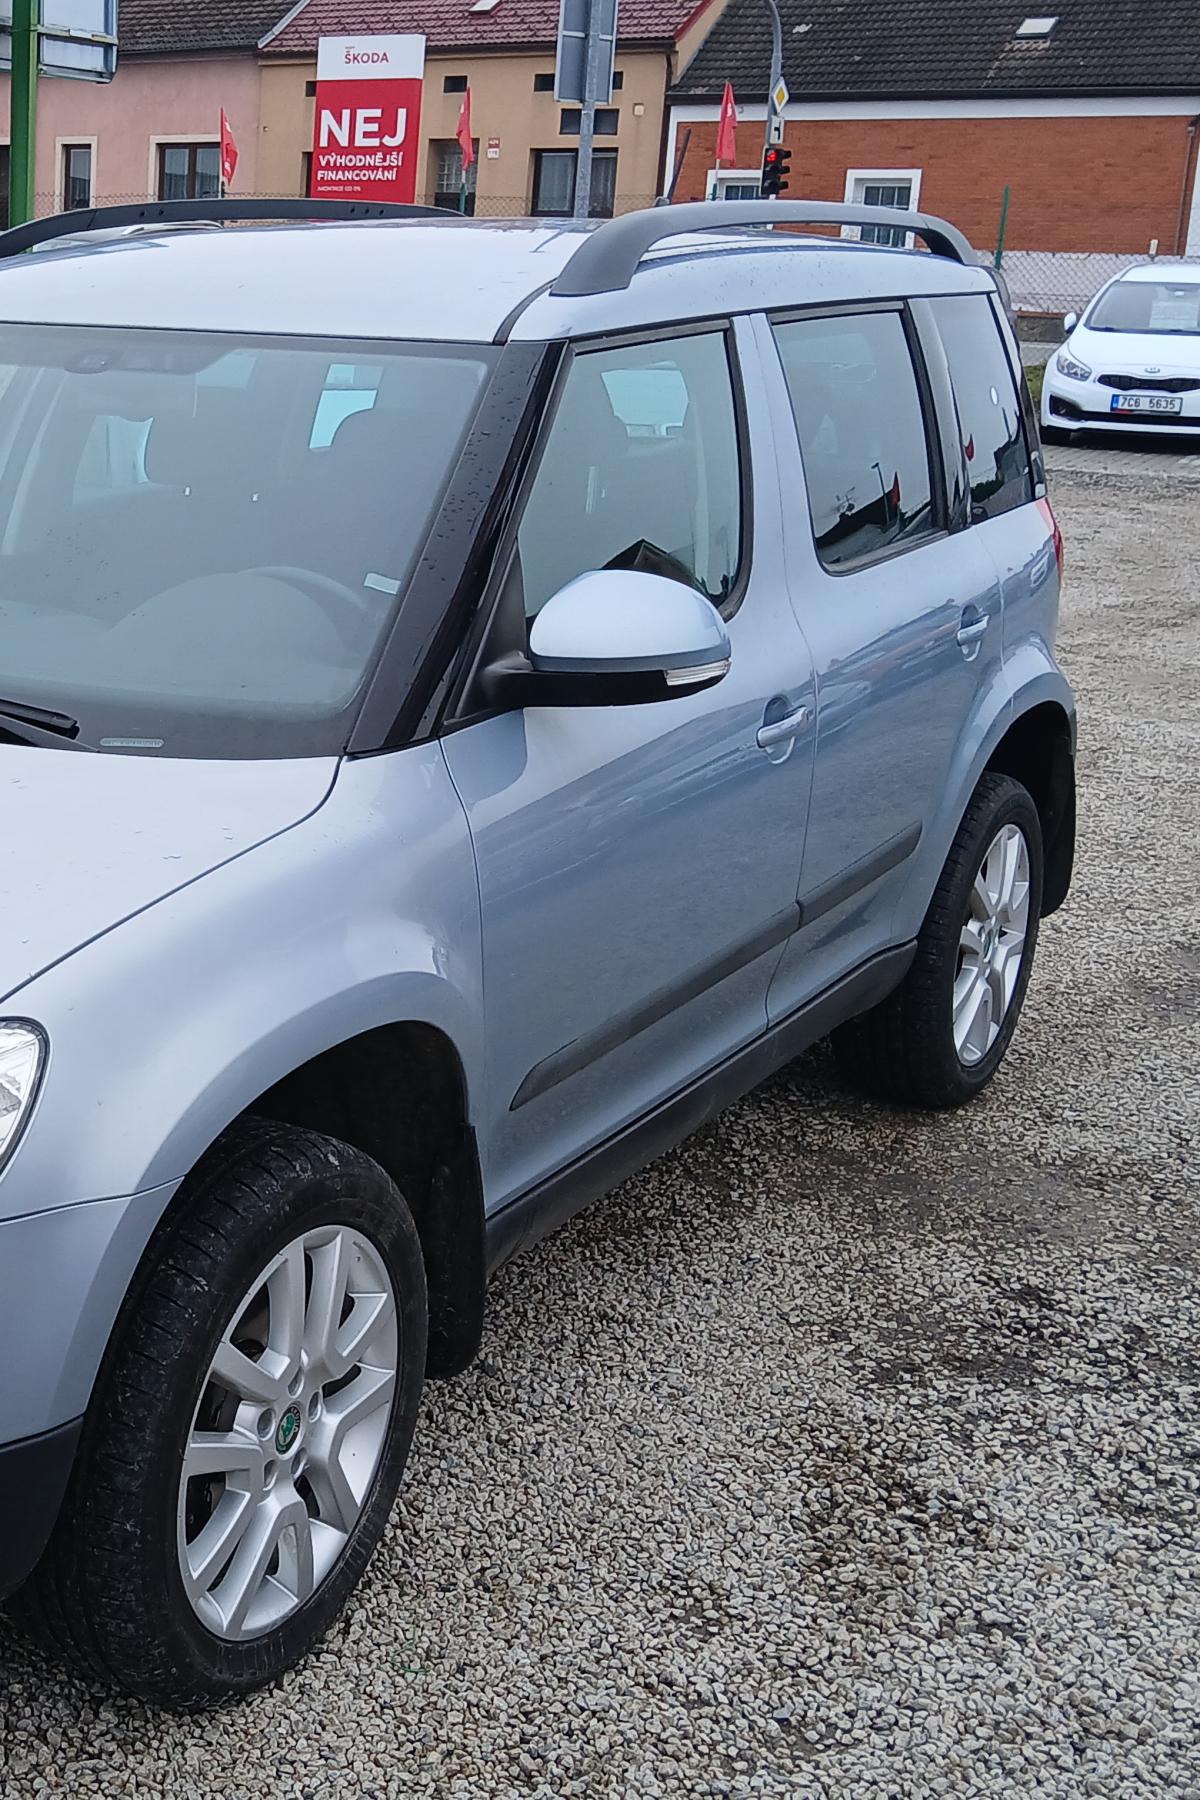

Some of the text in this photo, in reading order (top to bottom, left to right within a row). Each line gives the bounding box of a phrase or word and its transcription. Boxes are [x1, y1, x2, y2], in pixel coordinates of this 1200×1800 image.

[344, 50, 389, 64] ŠKODA
[319, 108, 407, 147] NEJ
[319, 151, 404, 167] VÝHODNĚJŠÍ
[317, 168, 398, 181] FINANCOVÁNÍ
